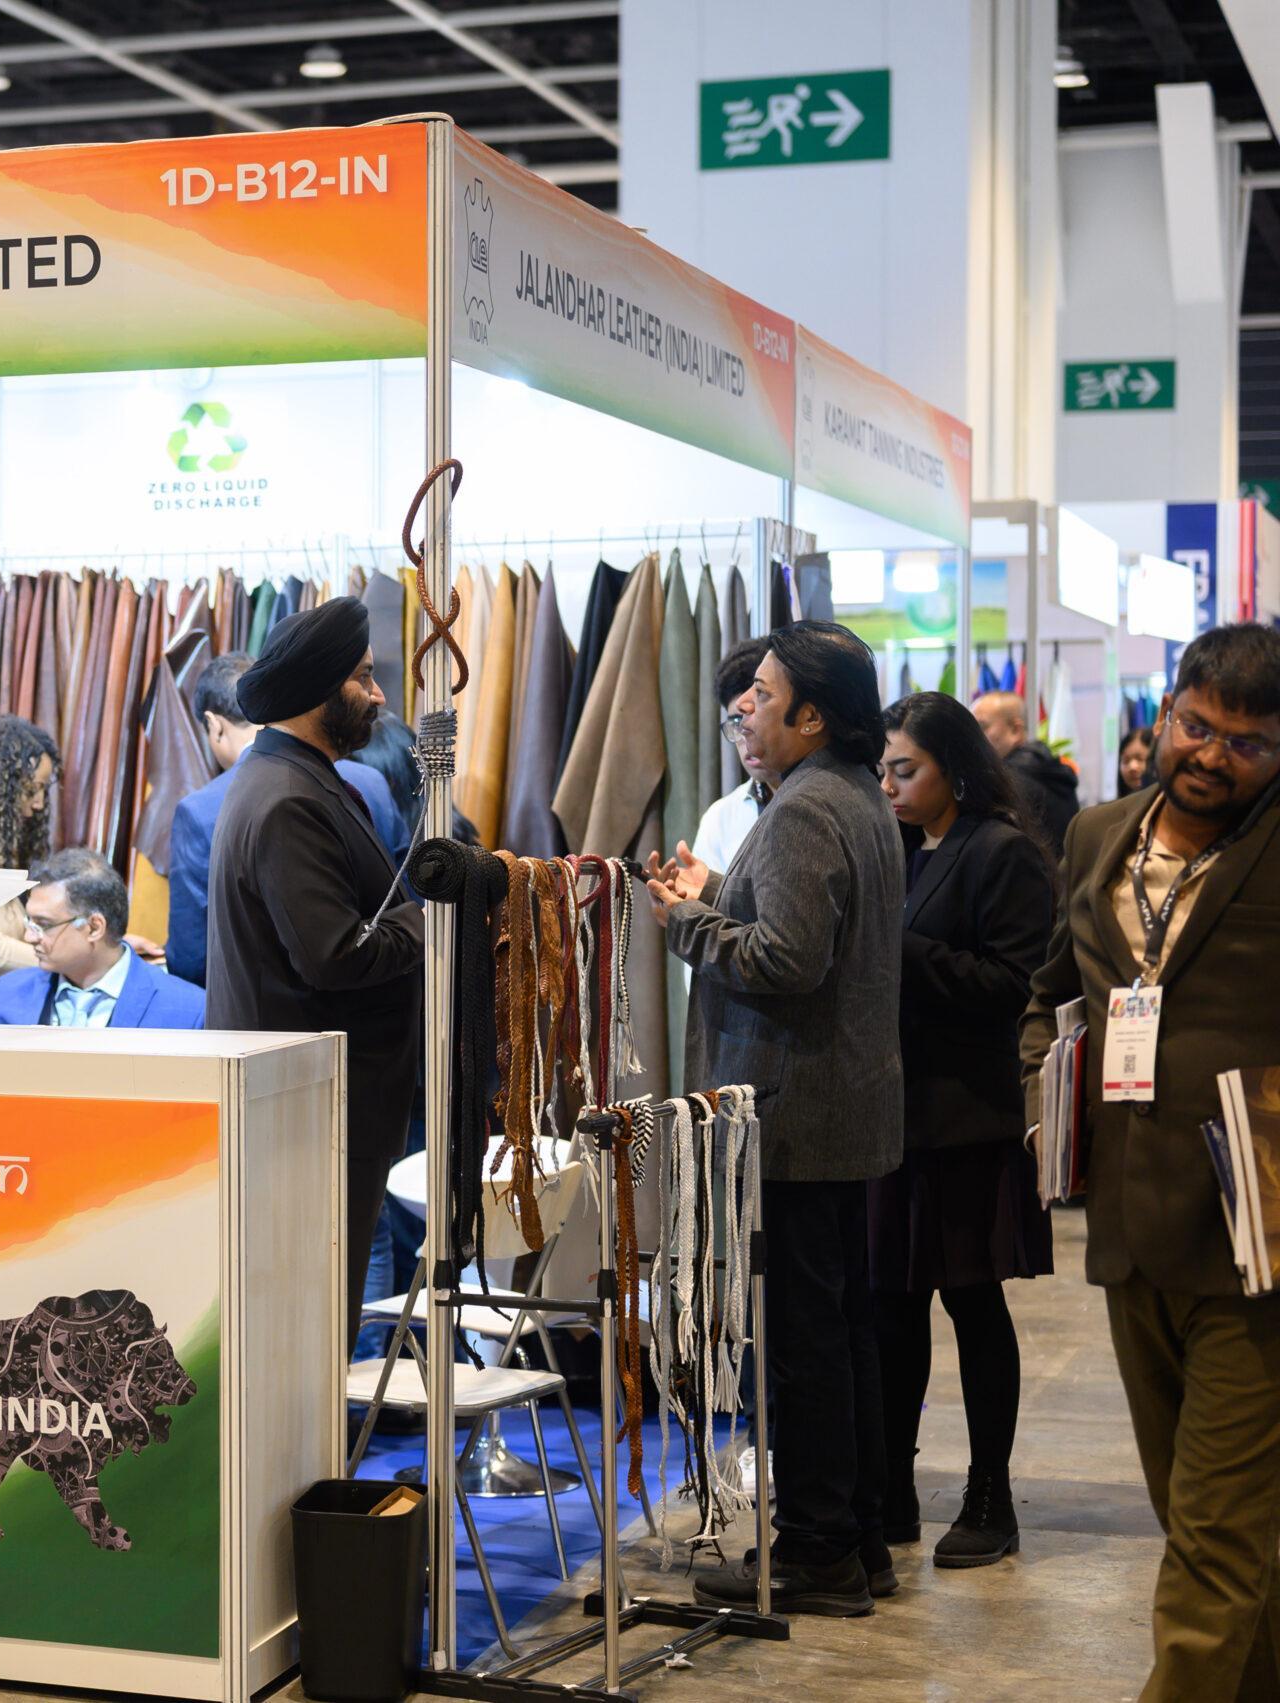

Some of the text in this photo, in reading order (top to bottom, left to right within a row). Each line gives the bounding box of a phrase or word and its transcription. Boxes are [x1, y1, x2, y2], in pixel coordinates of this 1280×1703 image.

[159, 154, 388, 207] 1D-B12-IN
[471, 319, 488, 346] INDIA
[516, 250, 746, 397] JALANDHAR LEATHER (INDIA) LIMITED
[148, 478, 268, 495] ZERO LIQUID
[154, 496, 261, 511] DISCHARGE
